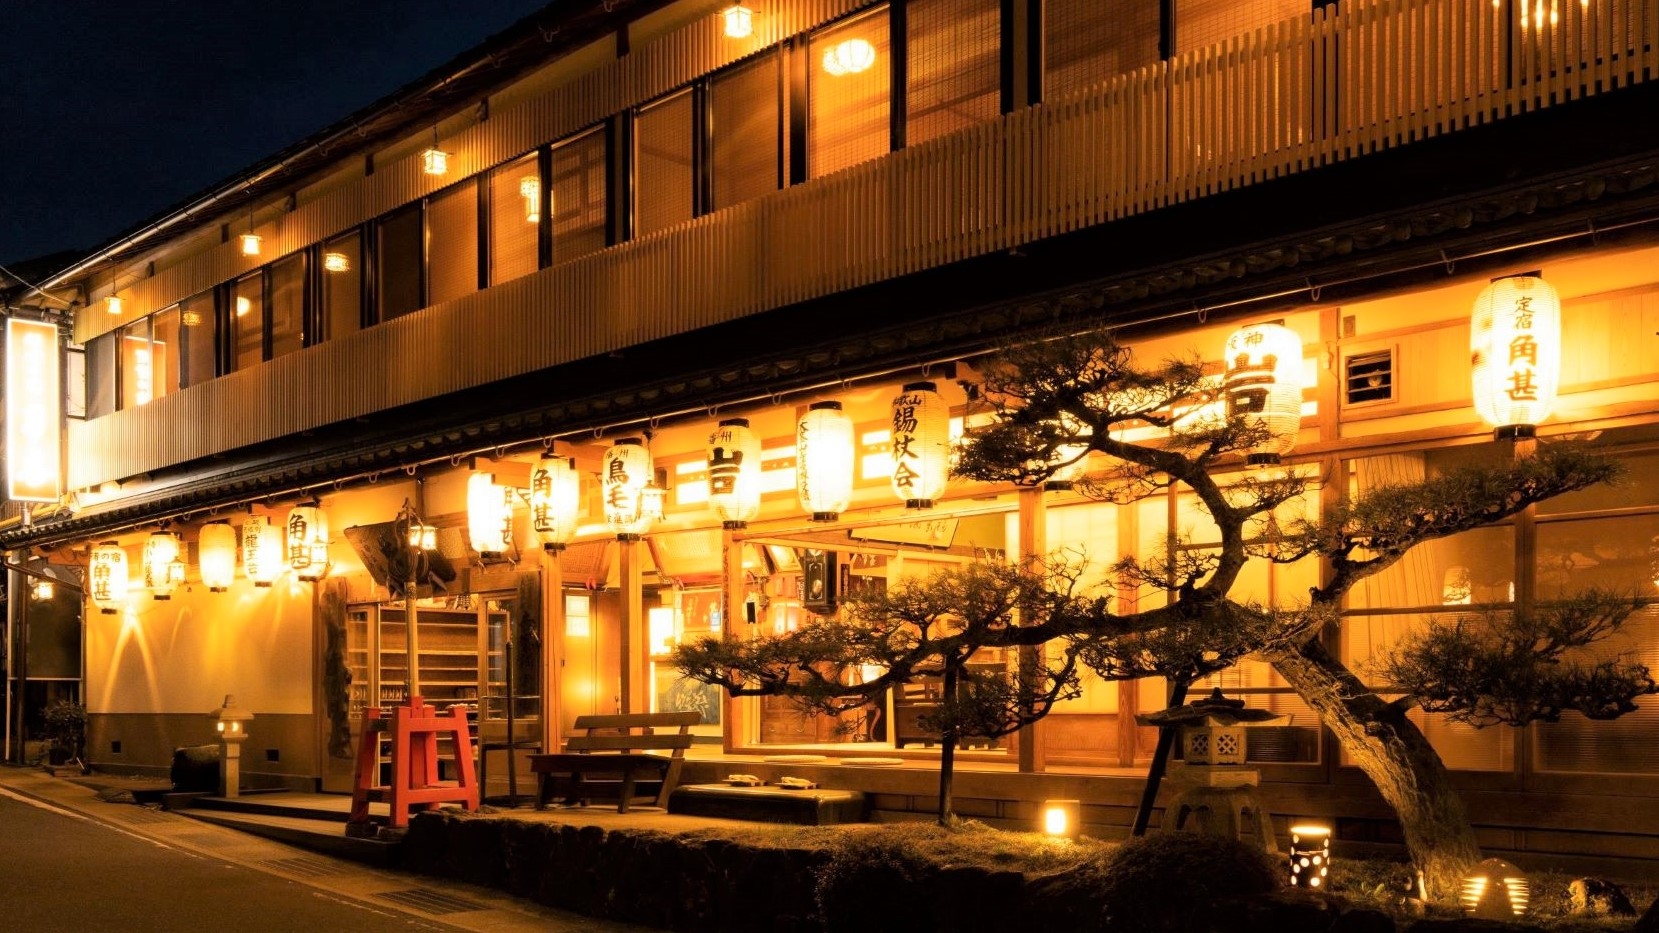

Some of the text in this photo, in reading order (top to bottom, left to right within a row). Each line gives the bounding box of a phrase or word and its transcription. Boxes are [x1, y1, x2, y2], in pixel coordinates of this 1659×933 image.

[1513, 295, 1537, 331] 定宿
[1504, 335, 1539, 401] 角甚
[892, 406, 920, 488] 錫杖会
[533, 468, 555, 532] 角甚
[605, 457, 630, 508] 鳥毛
[288, 513, 312, 569] 角甚
